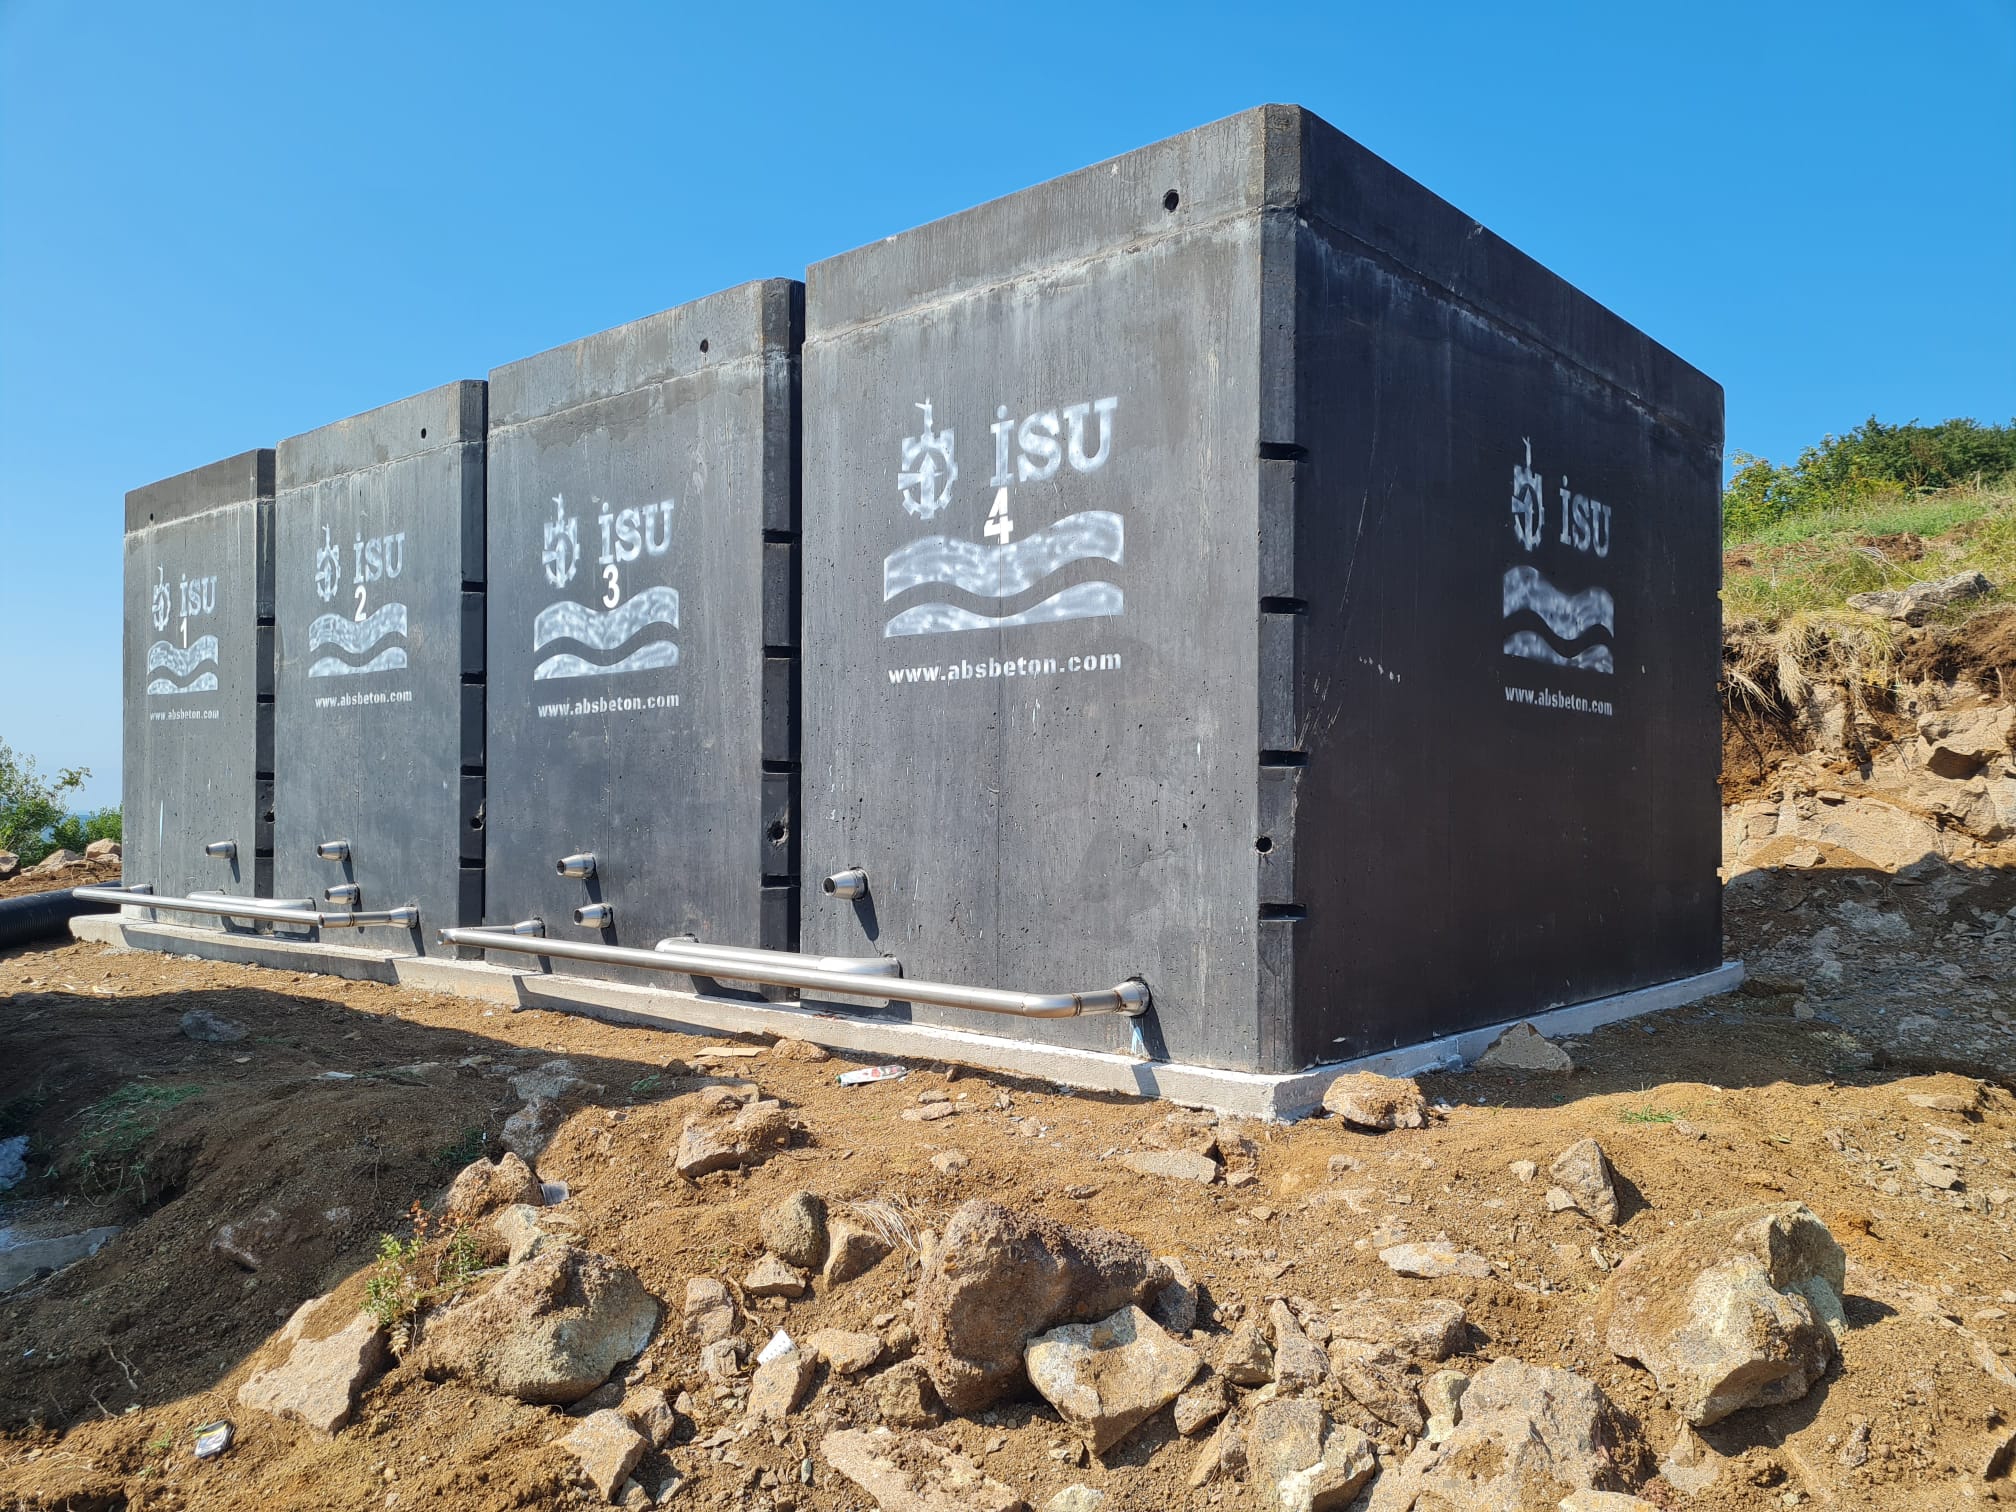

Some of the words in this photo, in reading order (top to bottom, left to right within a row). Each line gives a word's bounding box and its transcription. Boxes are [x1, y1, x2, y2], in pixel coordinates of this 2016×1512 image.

[984, 487, 1014, 545] 4
[602, 564, 621, 609] 3
[354, 585, 367, 622] 2
[179, 617, 188, 649] 1
[888, 652, 1122, 684] www.absbeton.com
[149, 708, 220, 721] www.absbeton.com
[314, 689, 413, 709] www.absbeton.com
[537, 694, 680, 718] www.absbeton.com
[1505, 686, 1613, 716] www.absbeton.com
